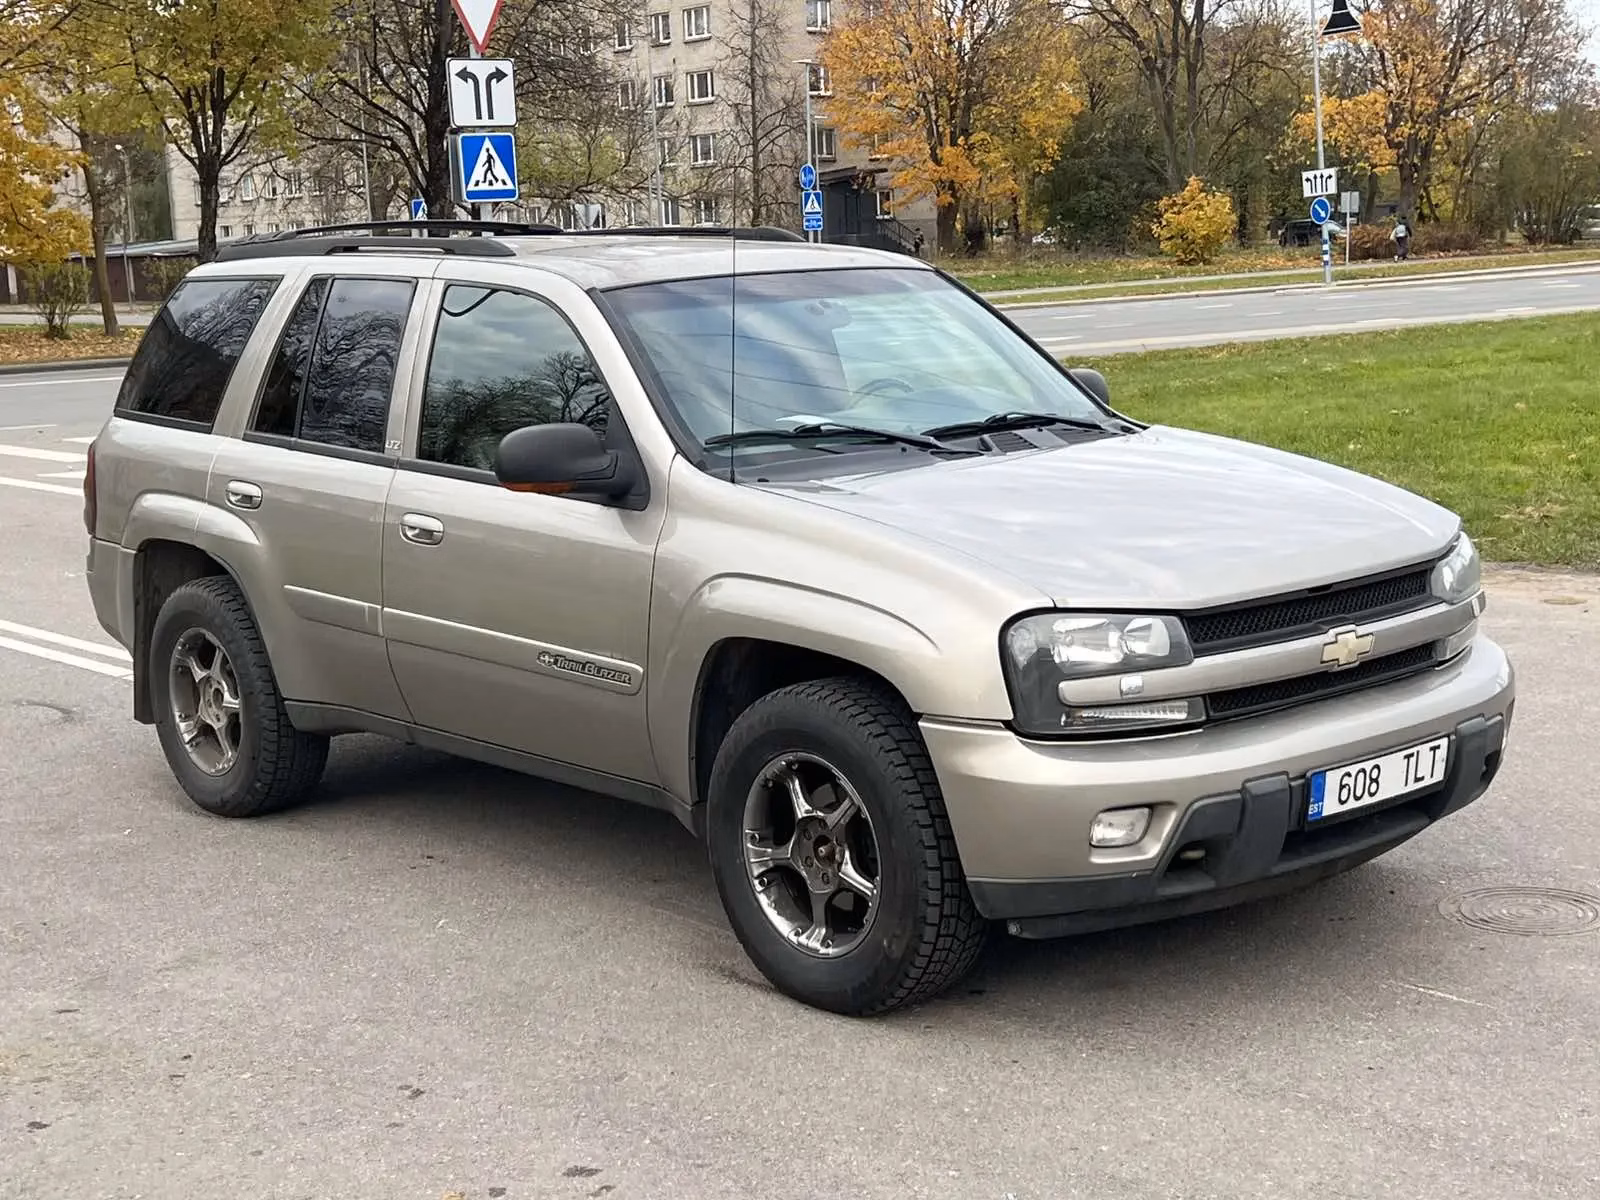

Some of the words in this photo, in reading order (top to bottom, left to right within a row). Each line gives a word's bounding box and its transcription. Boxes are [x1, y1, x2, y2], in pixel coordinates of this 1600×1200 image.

[1337, 763, 1381, 806] 608
[1403, 744, 1441, 787] TLT
[1308, 801, 1323, 815] EST
